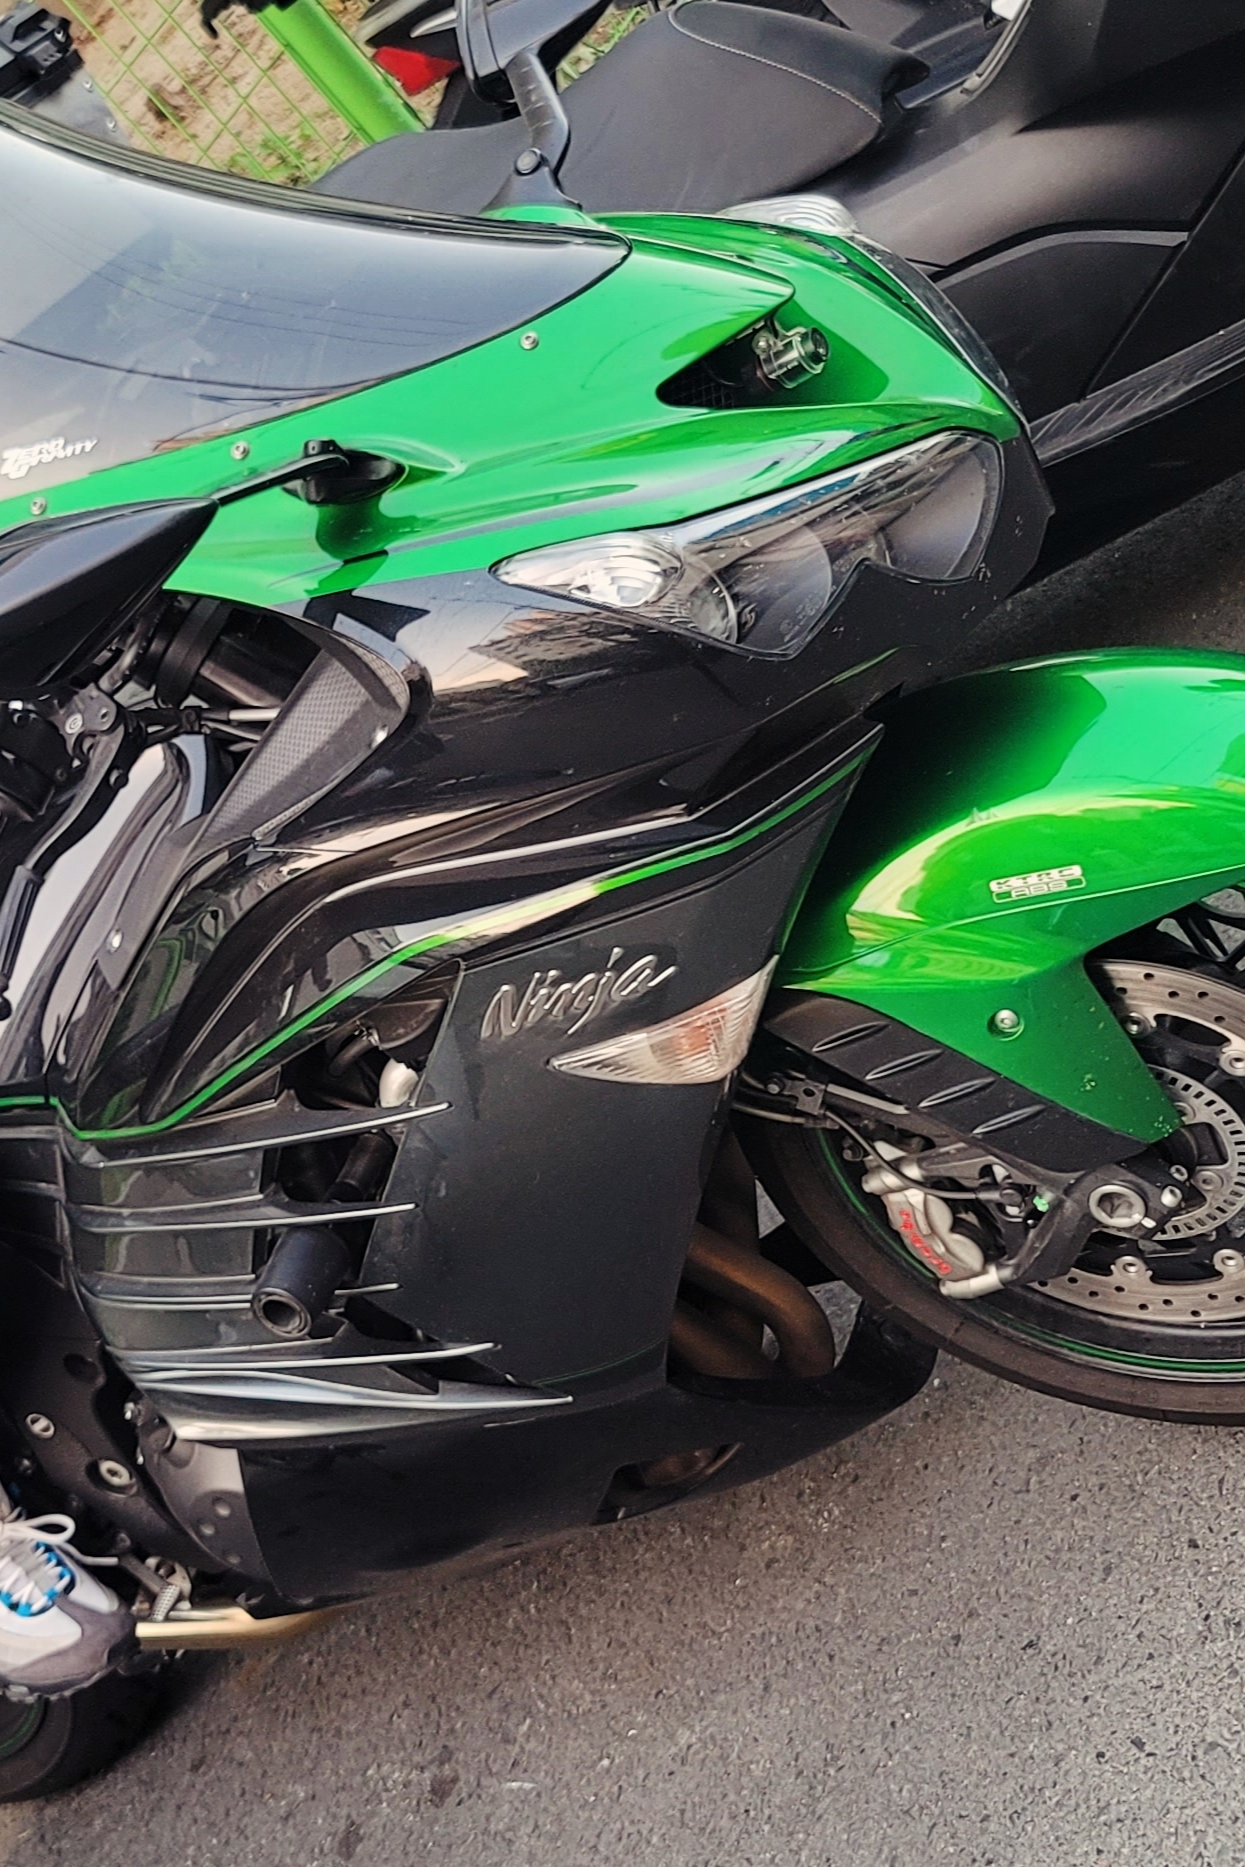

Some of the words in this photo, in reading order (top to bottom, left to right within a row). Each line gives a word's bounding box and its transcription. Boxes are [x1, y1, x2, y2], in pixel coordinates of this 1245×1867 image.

[0, 437, 65, 475] ZERO
[8, 438, 98, 479] GRAVITY
[996, 867, 1075, 889] KTRC
[1011, 880, 1067, 898] ABS
[480, 947, 678, 1040] Ninja
